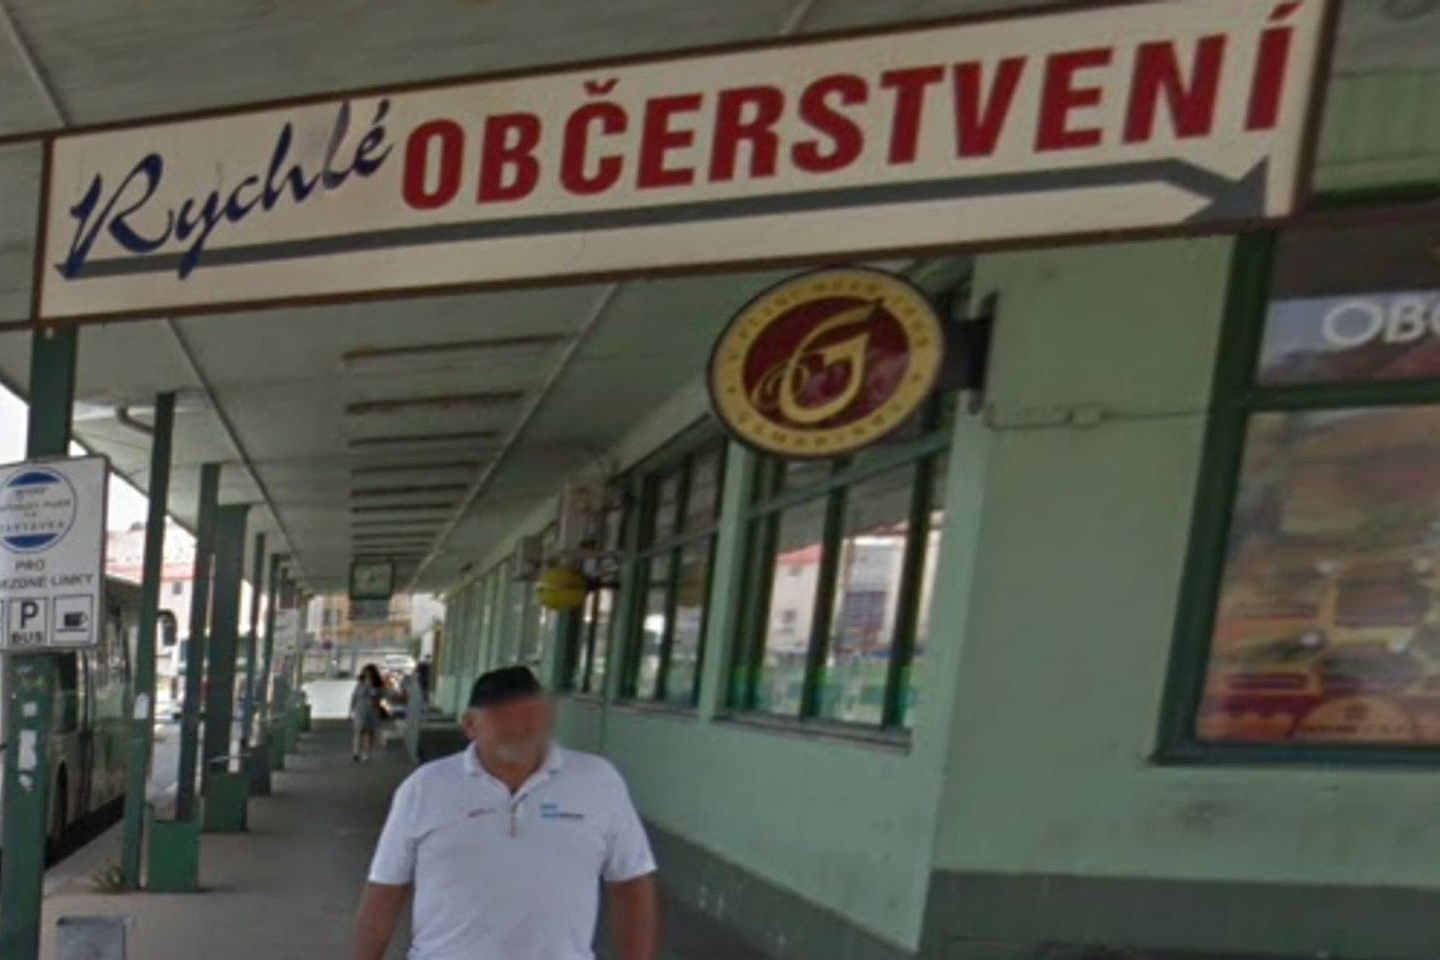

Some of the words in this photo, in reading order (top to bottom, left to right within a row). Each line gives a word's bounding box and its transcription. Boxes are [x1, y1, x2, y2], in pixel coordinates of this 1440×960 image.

[64, 98, 394, 280] Rychlé
[400, 1, 1306, 213] OBČERSTVENÍ
[15, 558, 46, 572] PRO
[50, 573, 94, 587] LINKY
[20, 601, 39, 630] P
